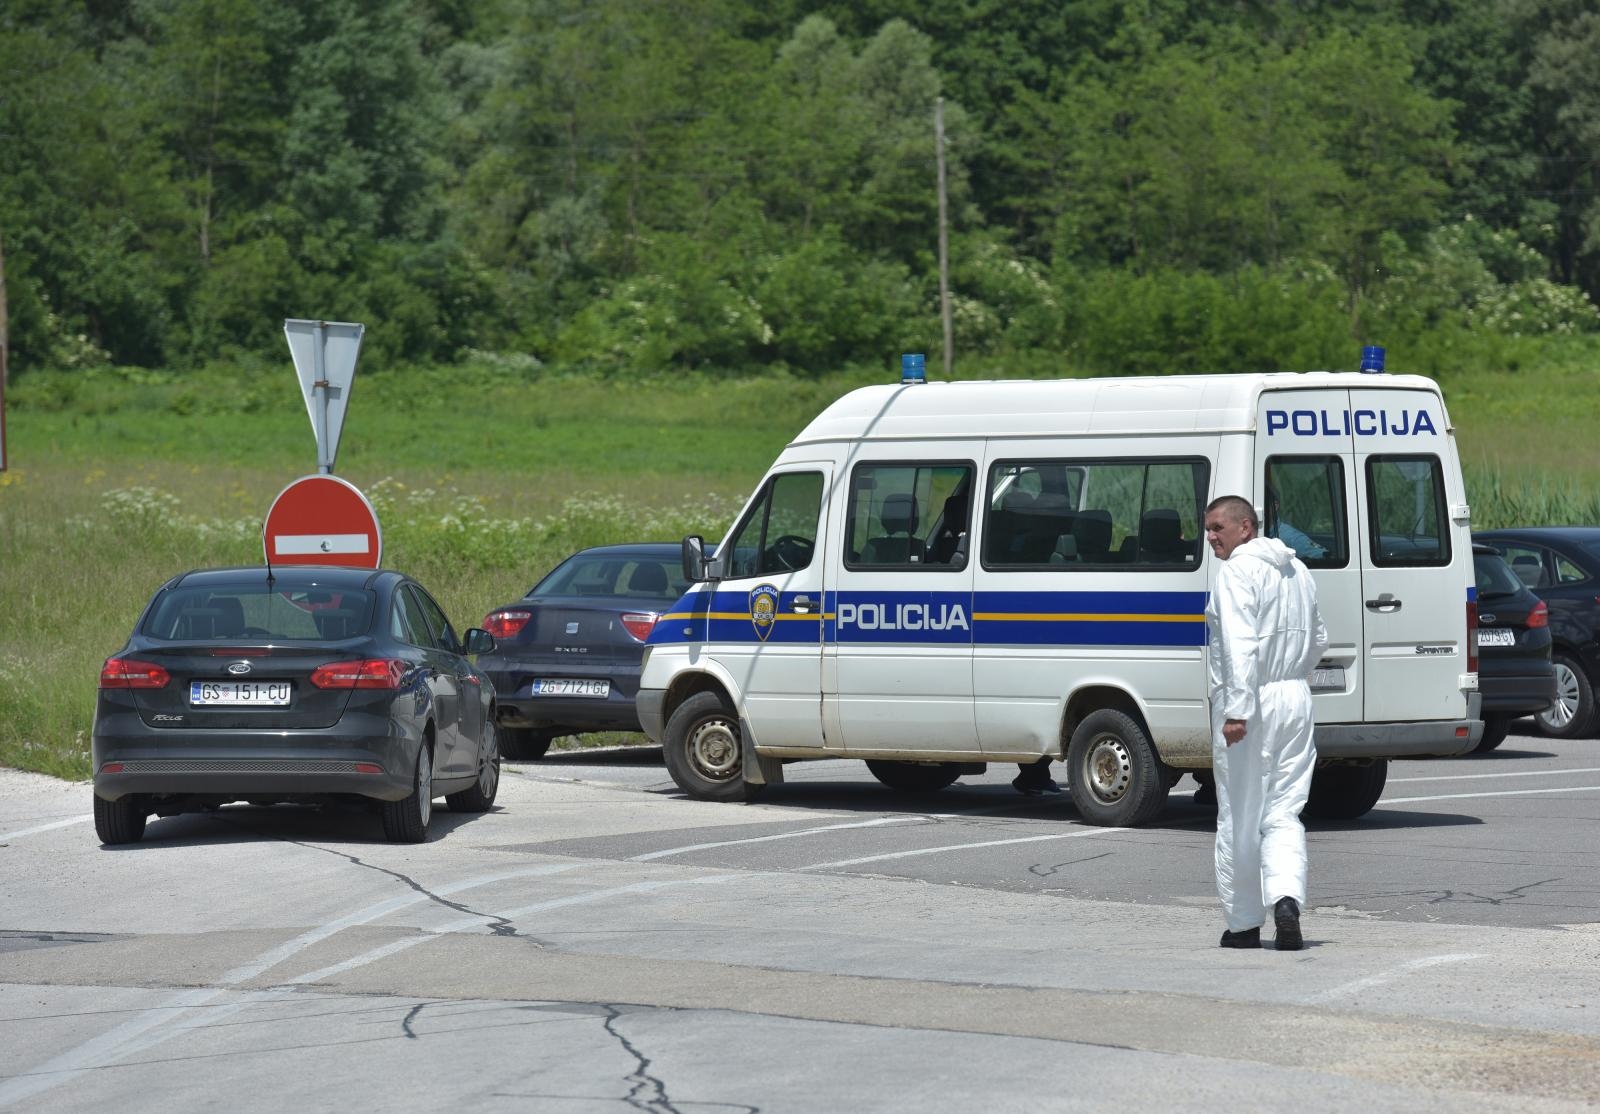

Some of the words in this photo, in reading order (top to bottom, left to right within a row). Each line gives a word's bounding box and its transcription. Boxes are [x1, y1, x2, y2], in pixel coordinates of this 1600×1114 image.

[1266, 409, 1437, 437] POLICIJA
[752, 586, 778, 598] POLICIJA
[837, 603, 969, 631] POLICIJA
[202, 684, 220, 700] GS
[235, 684, 289, 700] 151-CU
[541, 680, 556, 693] ZG
